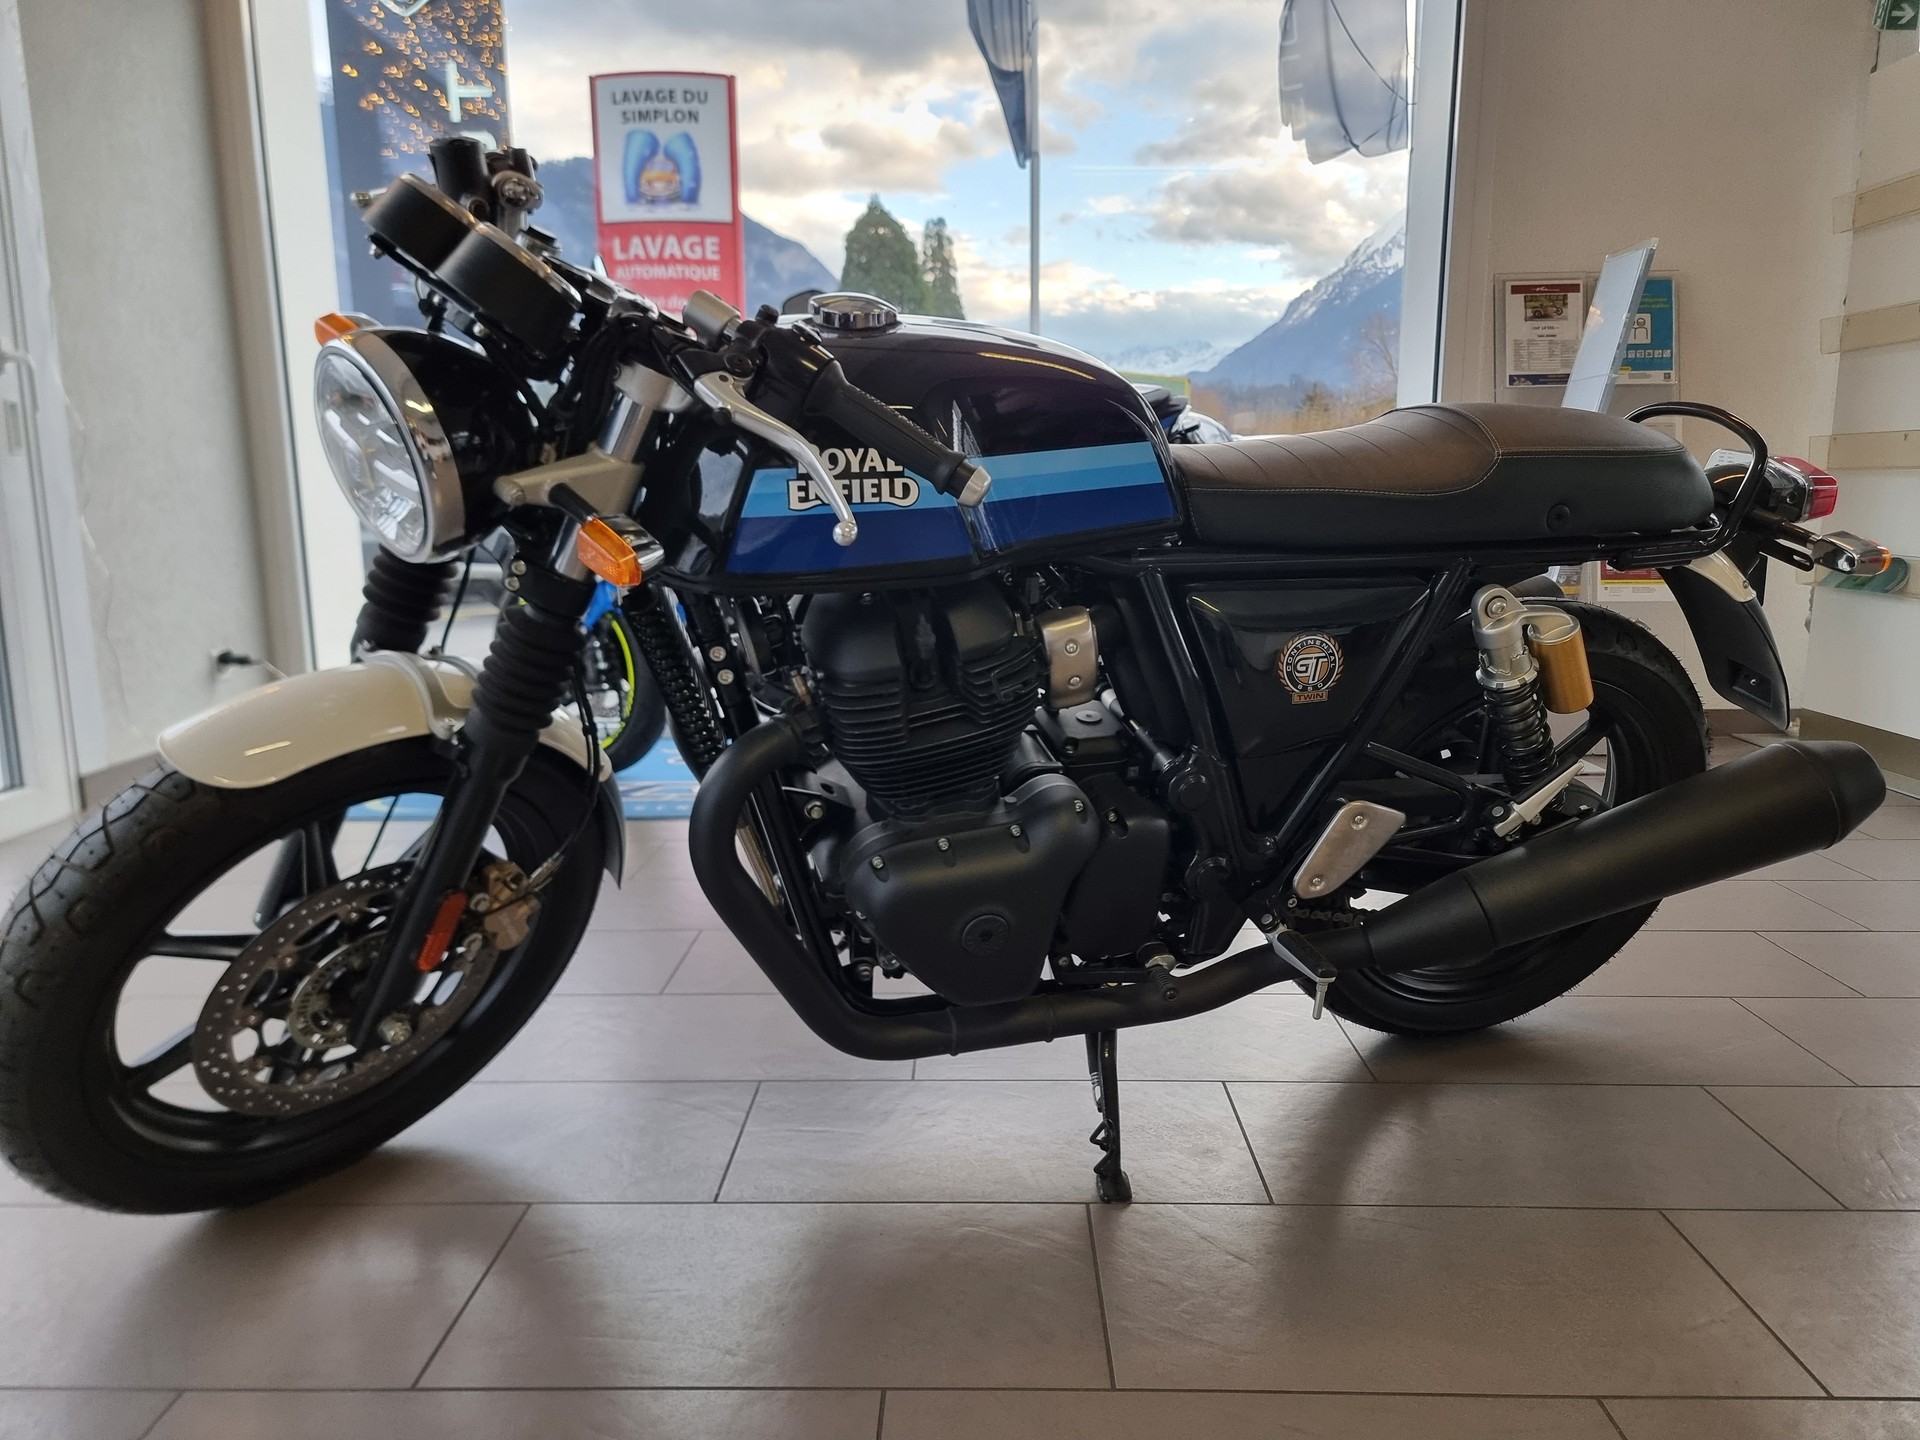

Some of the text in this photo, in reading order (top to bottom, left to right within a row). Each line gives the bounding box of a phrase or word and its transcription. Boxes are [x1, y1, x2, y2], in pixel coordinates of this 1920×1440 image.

[611, 90, 708, 106] LAVAGE DU
[621, 109, 700, 125] SIMPLON
[612, 234, 721, 261] LAVAGE
[616, 264, 721, 282] AUTOMATIQUE
[1286, 639, 1336, 672] CONTINENTAL
[1295, 652, 1328, 684] GT
[1297, 682, 1324, 692] 650
[1297, 692, 1324, 701] TWIN
